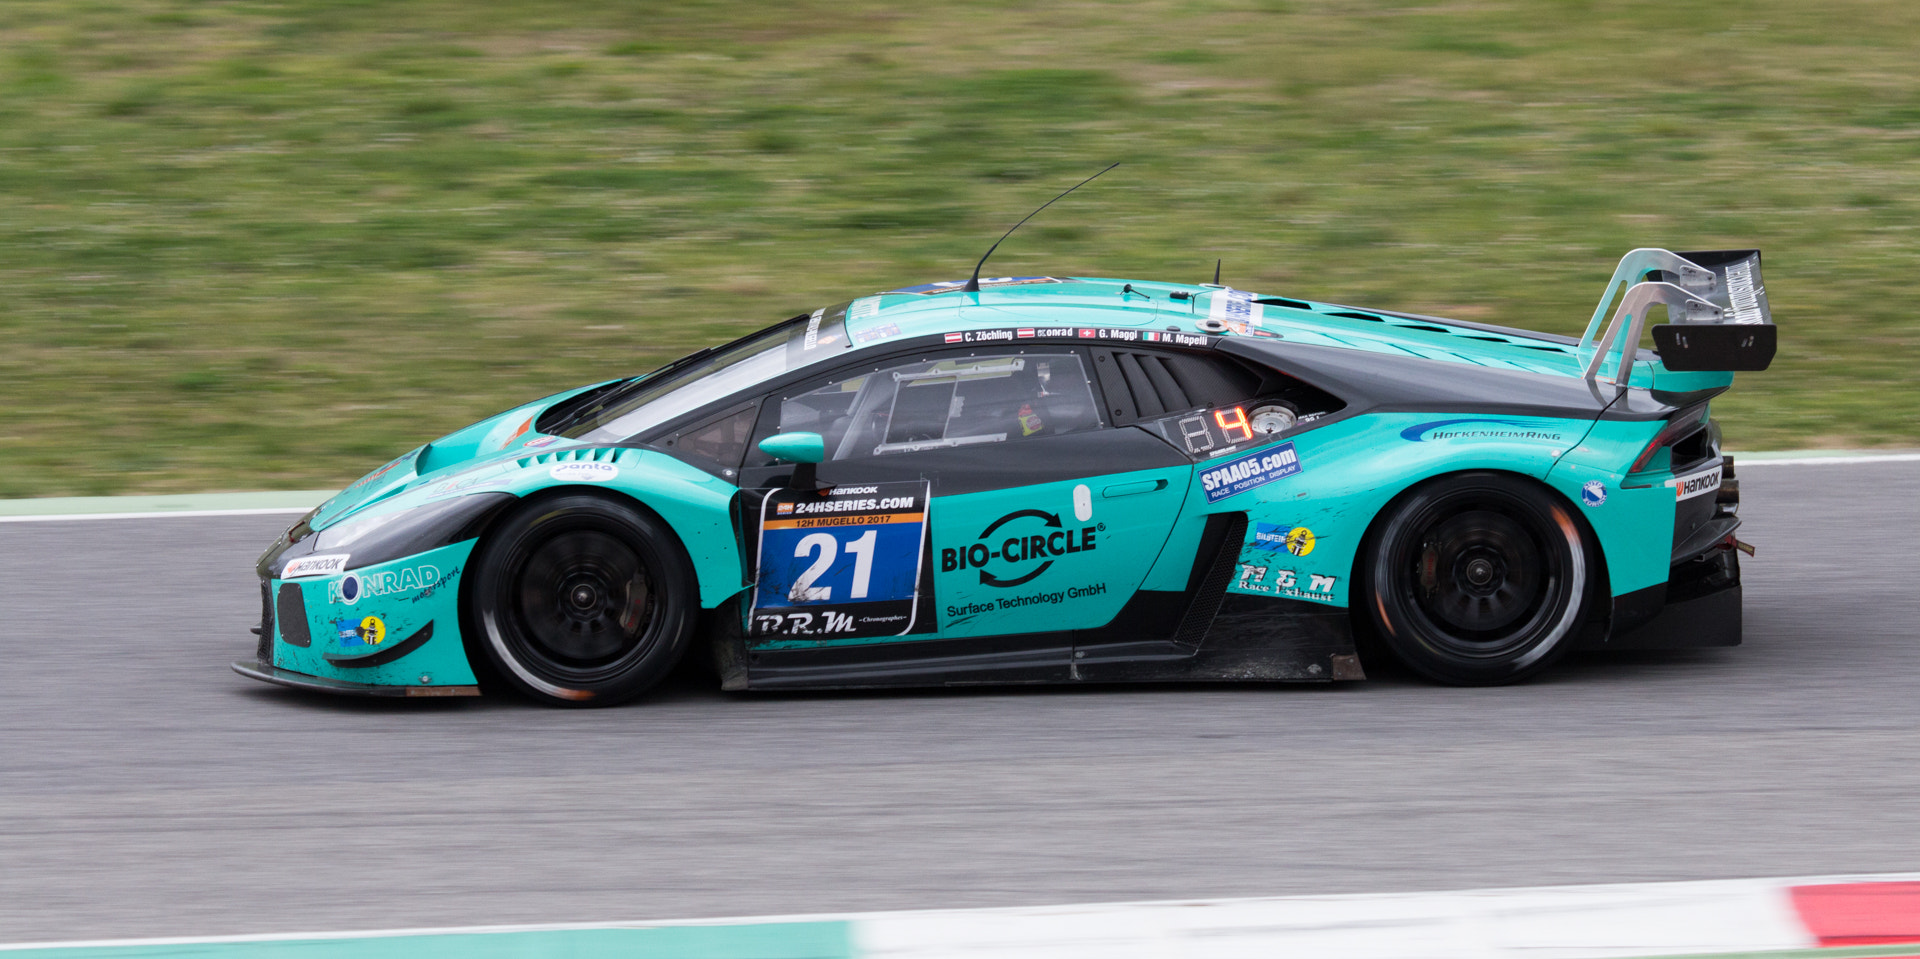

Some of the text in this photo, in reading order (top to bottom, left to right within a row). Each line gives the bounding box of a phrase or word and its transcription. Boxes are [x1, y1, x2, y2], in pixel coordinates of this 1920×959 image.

[965, 330, 1013, 342] C. Zöchling
[1099, 329, 1138, 341] G. Maggi
[1162, 333, 1208, 346] M. Mapelli
[1202, 448, 1298, 492] SPAA05.com
[1211, 465, 1296, 499] RACE POSITION DISPLAY
[796, 497, 914, 514] 24HSERIES.COM
[796, 515, 891, 528] 12H MUGELLO 2017
[788, 530, 877, 602] 21
[1241, 564, 1268, 583] M
[1310, 573, 1337, 593] M
[328, 565, 440, 605] KONRAD
[412, 566, 460, 604] morsport
[1238, 580, 1335, 602] Race Exhaust
[947, 583, 1107, 617] Surface Technology GmbH
